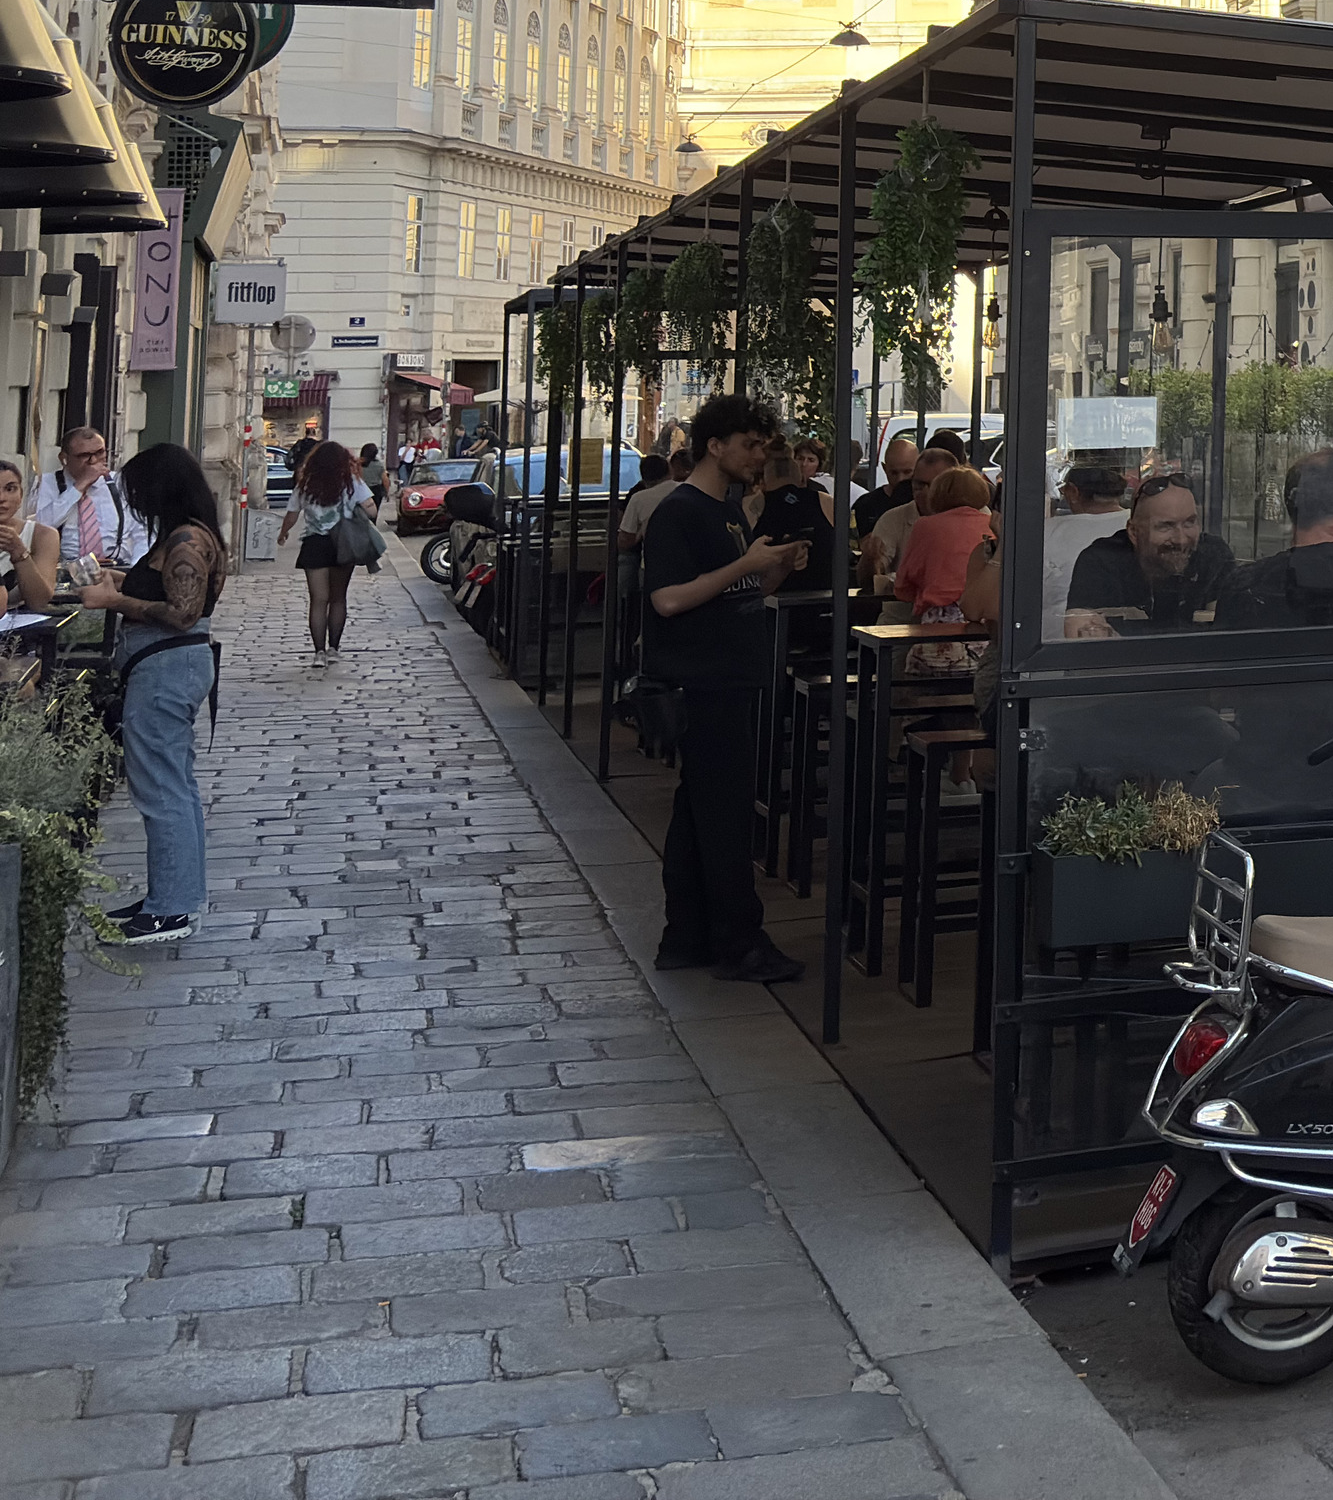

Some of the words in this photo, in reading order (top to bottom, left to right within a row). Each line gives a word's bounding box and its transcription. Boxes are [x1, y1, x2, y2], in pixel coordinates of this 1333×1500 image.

[165, 11, 177, 21] 17
[120, 23, 248, 52] GUINNESS
[227, 281, 276, 305] fitflop
